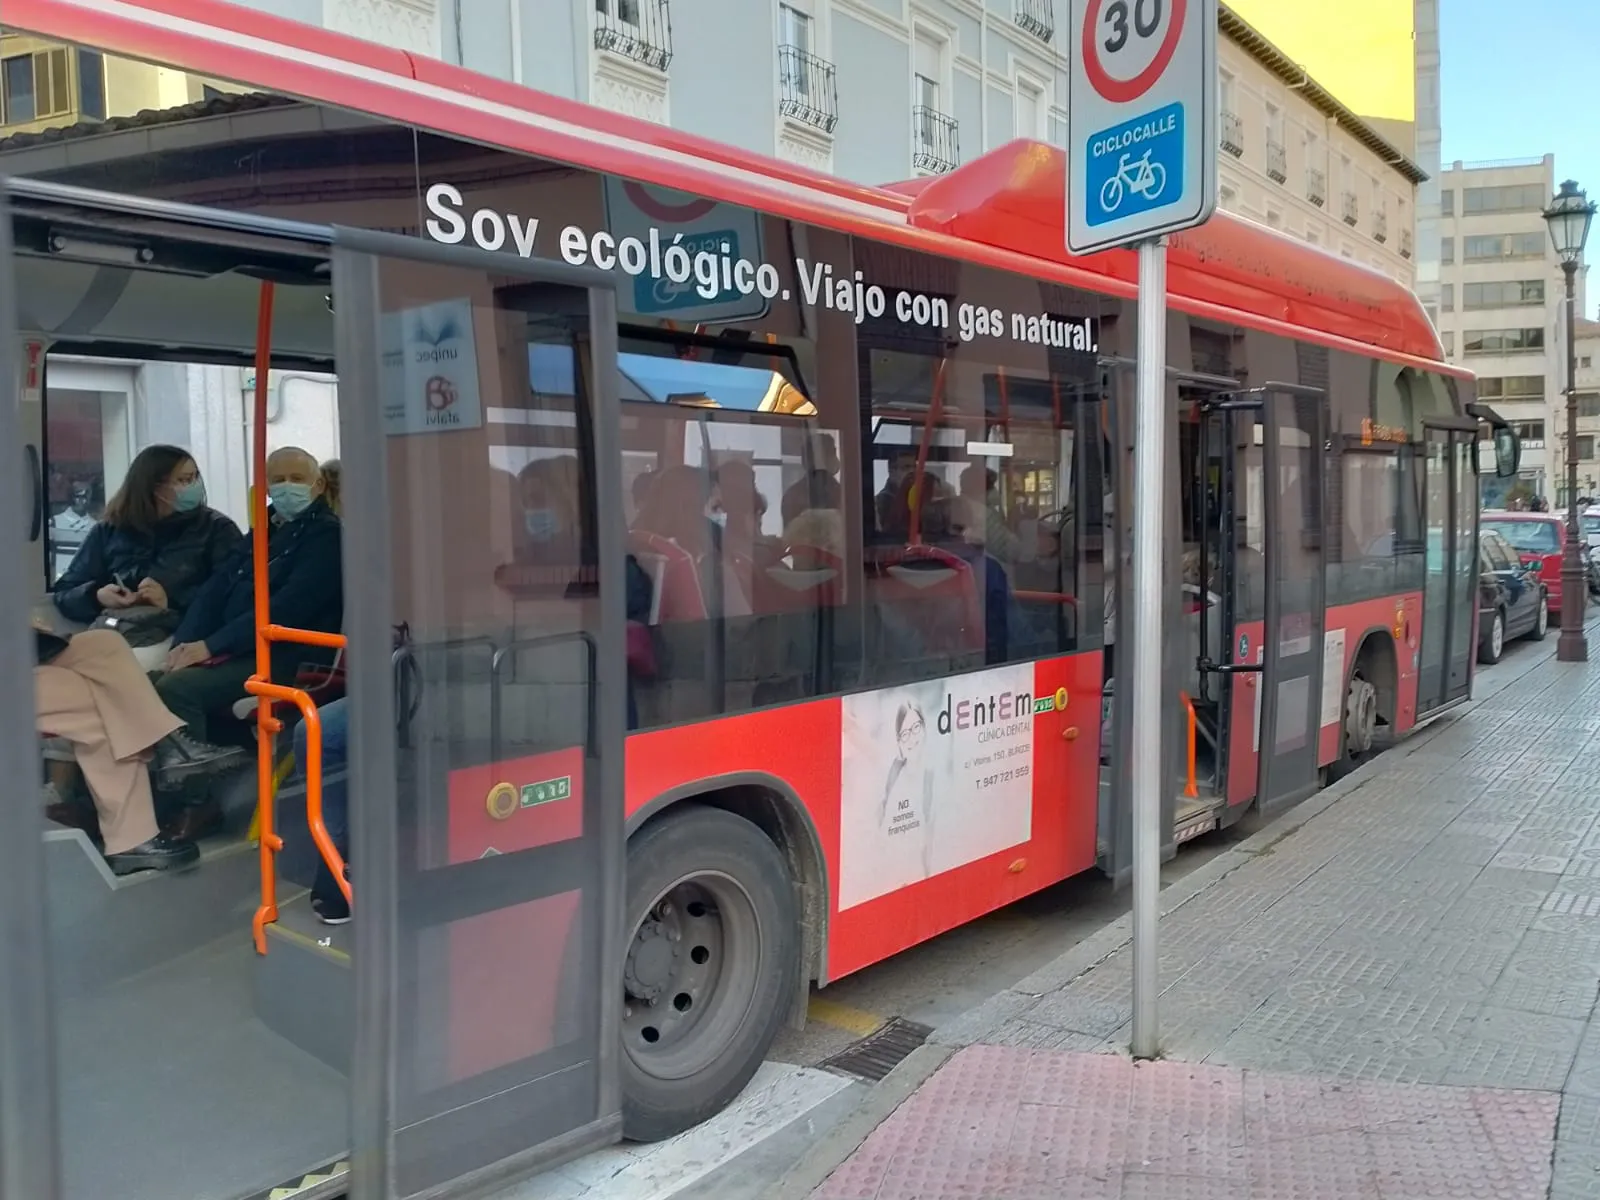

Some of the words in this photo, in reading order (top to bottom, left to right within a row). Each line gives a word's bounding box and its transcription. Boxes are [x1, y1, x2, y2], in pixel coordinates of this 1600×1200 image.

[1104, 0, 1162, 53] 30
[1093, 114, 1176, 157] CICLOCALLE
[559, 225, 791, 301] ecológico.
[796, 257, 885, 324] Viajo
[895, 290, 949, 328] con
[958, 302, 1004, 342] gas
[1011, 311, 1098, 353] natural.
[1006, 721, 1031, 737] DENTAL
[983, 774, 998, 787] 947
[999, 769, 1013, 782] 721
[898, 799, 909, 810] NO
